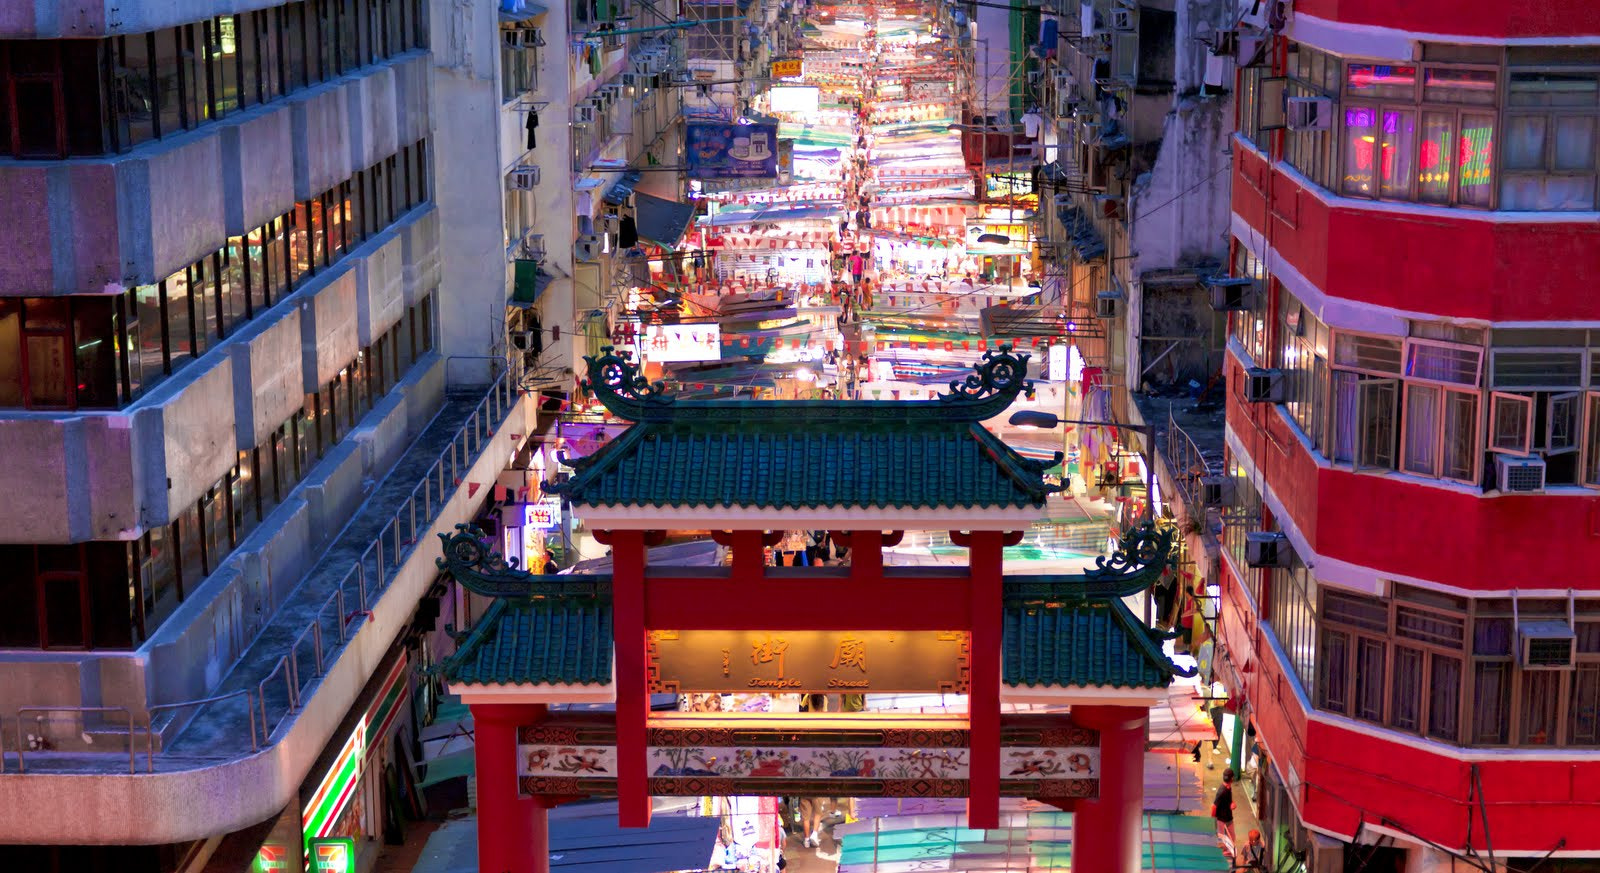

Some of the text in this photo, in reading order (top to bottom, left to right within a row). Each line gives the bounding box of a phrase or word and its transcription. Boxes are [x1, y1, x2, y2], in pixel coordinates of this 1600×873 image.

[750, 635, 789, 679] 街
[828, 634, 866, 672] 廟
[748, 677, 870, 689] Temple Street
